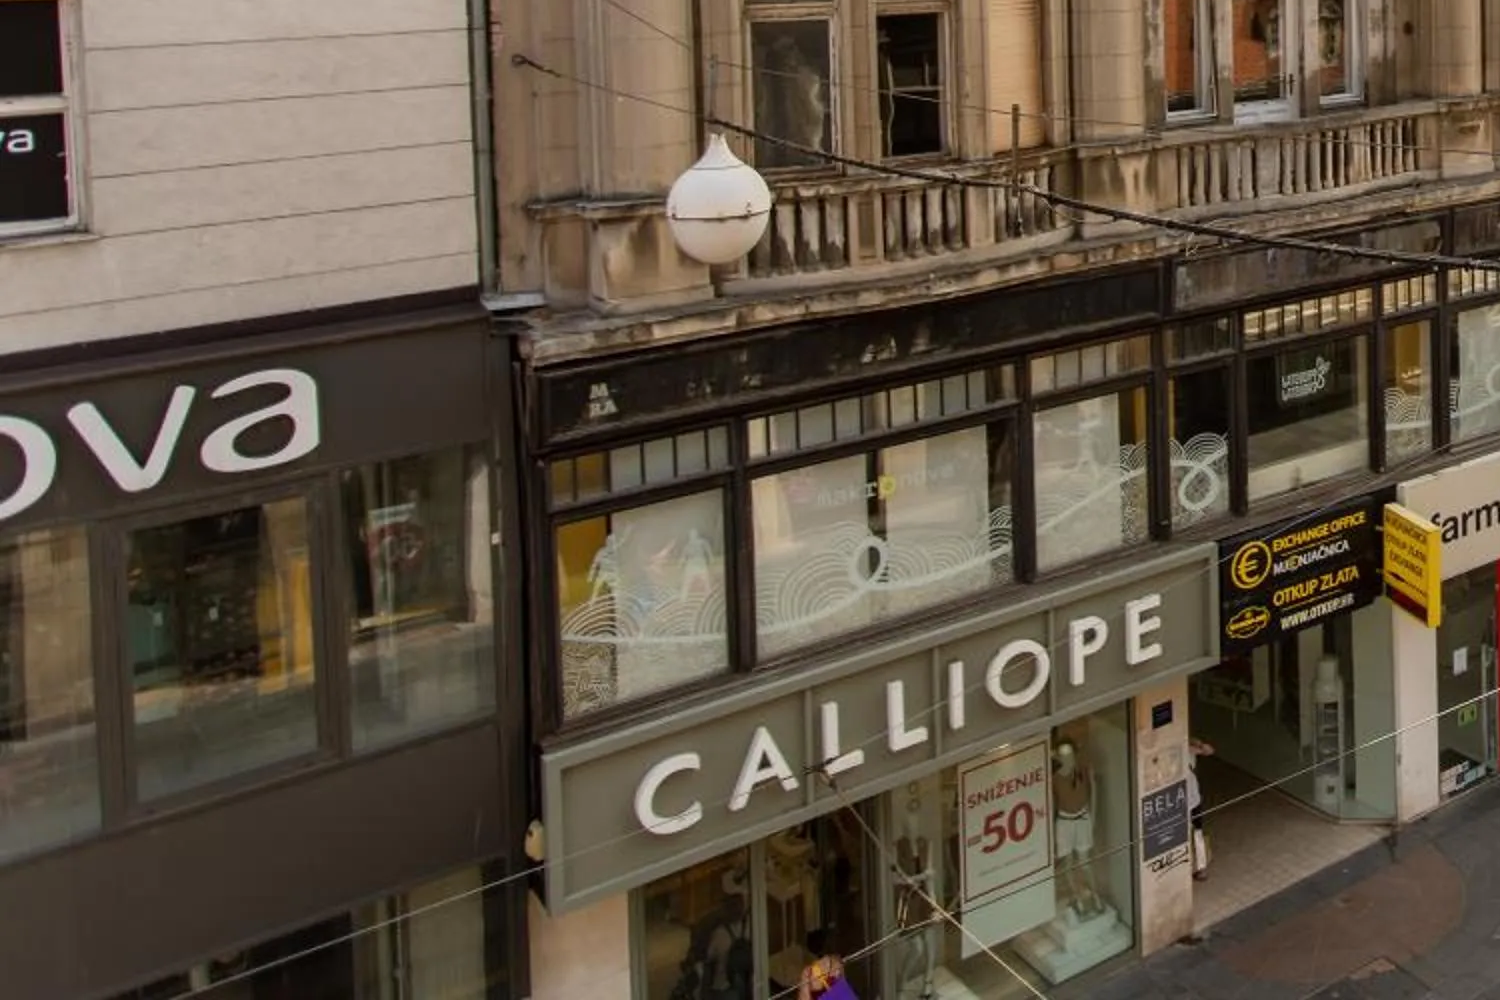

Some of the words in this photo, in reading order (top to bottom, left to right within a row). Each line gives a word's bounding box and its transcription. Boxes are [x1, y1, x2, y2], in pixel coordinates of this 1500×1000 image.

[1272, 523, 1330, 552] EXCHANGE
[1329, 511, 1366, 533] OFFICE
[1273, 578, 1318, 606] OTKUP
[1320, 565, 1360, 590] ZLATA
[635, 593, 1162, 835] CALLIOPE
[1143, 787, 1185, 817] BELA
